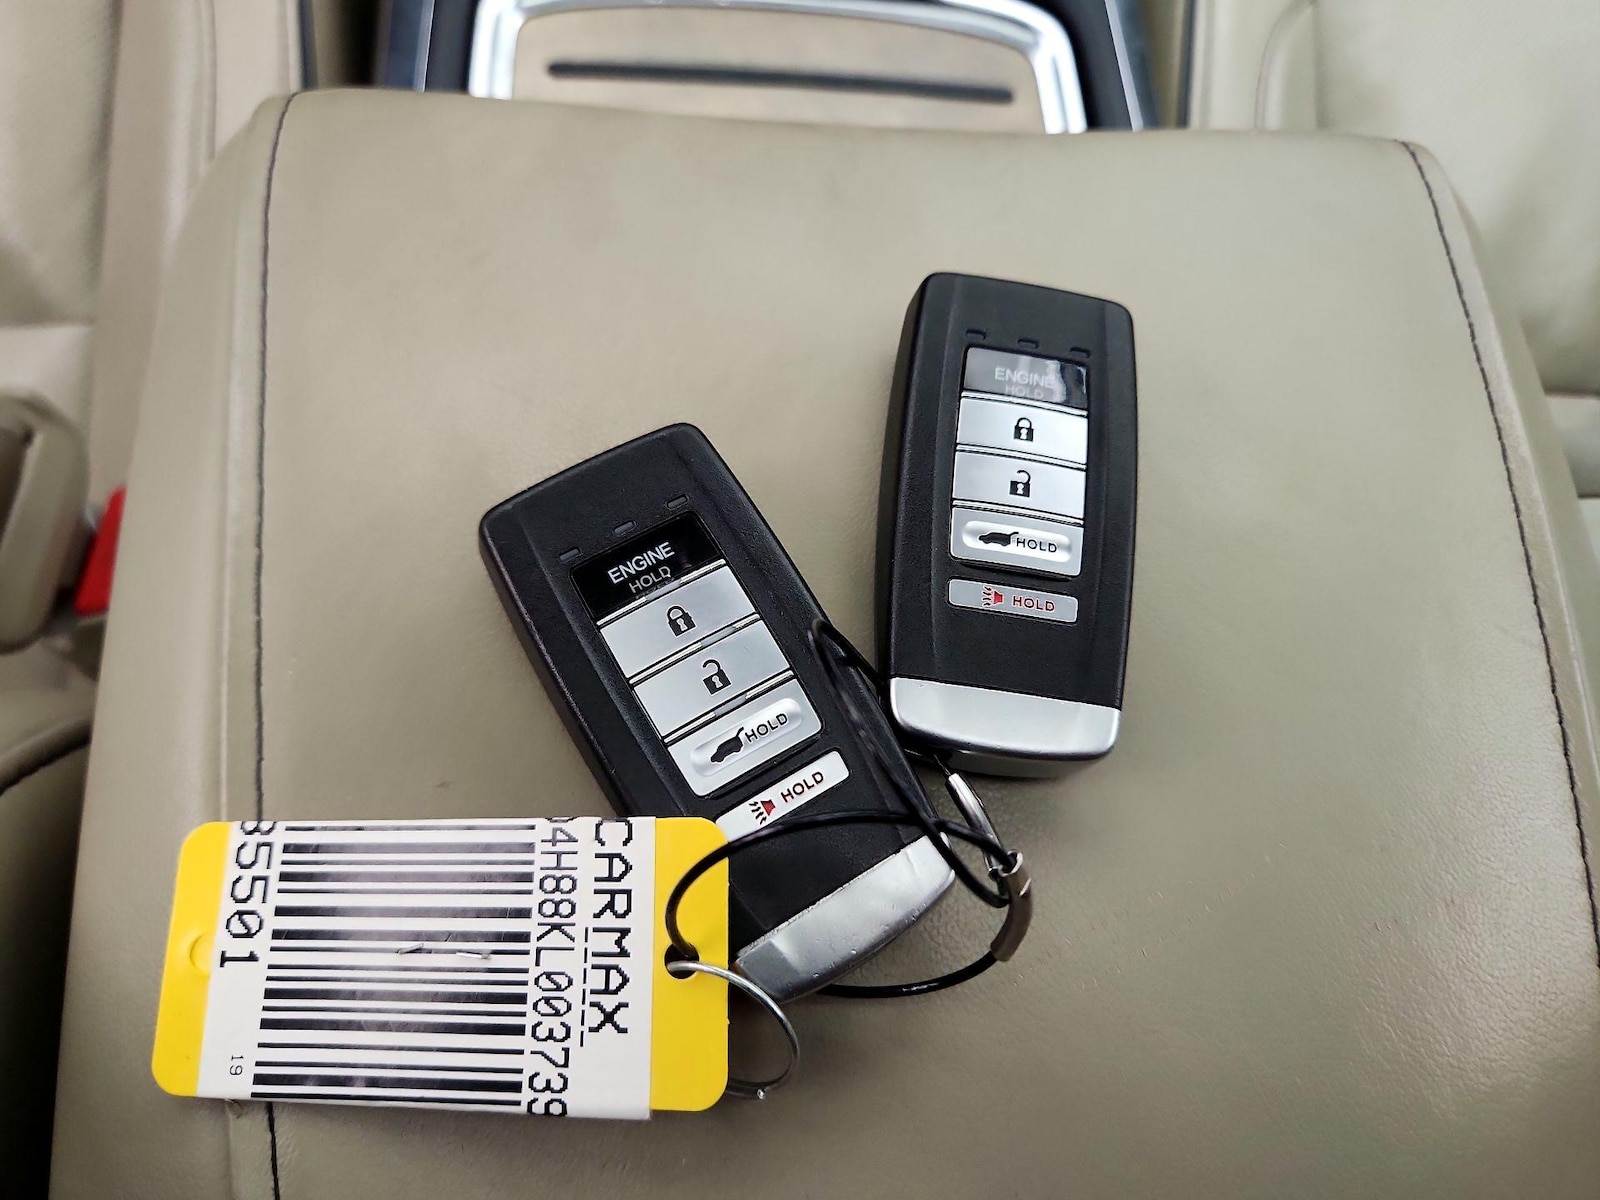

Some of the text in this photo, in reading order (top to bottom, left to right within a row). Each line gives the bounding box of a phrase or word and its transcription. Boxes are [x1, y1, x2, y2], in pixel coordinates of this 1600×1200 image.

[994, 366, 1055, 389] ENGINE
[1005, 384, 1044, 399] HOLD
[1016, 537, 1057, 553] HOLD
[607, 541, 675, 584] ENGINE
[628, 566, 672, 593] HOLD
[1012, 595, 1055, 612] HOLD
[745, 713, 788, 743] HOLD
[780, 771, 824, 803] HOLD
[588, 818, 633, 1034] CARMAX
[527, 817, 579, 1117] 4H88KL003739
[230, 1055, 244, 1076] 19
